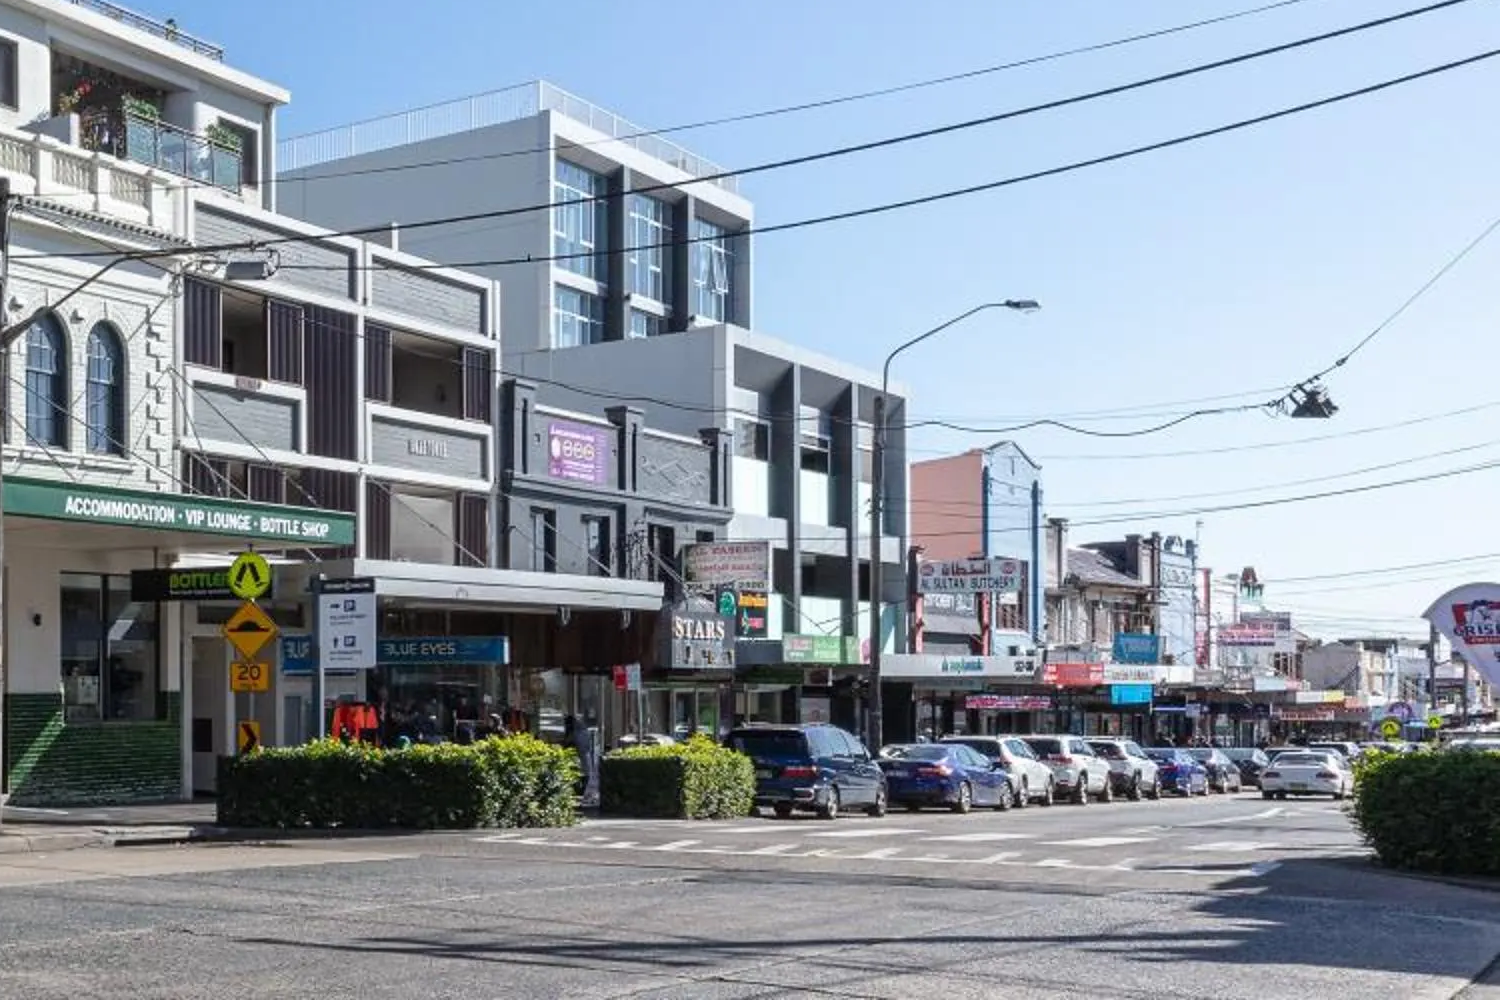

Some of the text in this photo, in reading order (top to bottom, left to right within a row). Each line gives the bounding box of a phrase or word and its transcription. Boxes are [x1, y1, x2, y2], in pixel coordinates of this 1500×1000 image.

[64, 496, 329, 538] ACCOMMODATION VIP LOUNGE BOTTLE SHOP
[674, 615, 726, 640] STARS
[420, 641, 457, 656] EYES
[237, 665, 261, 681] 20
